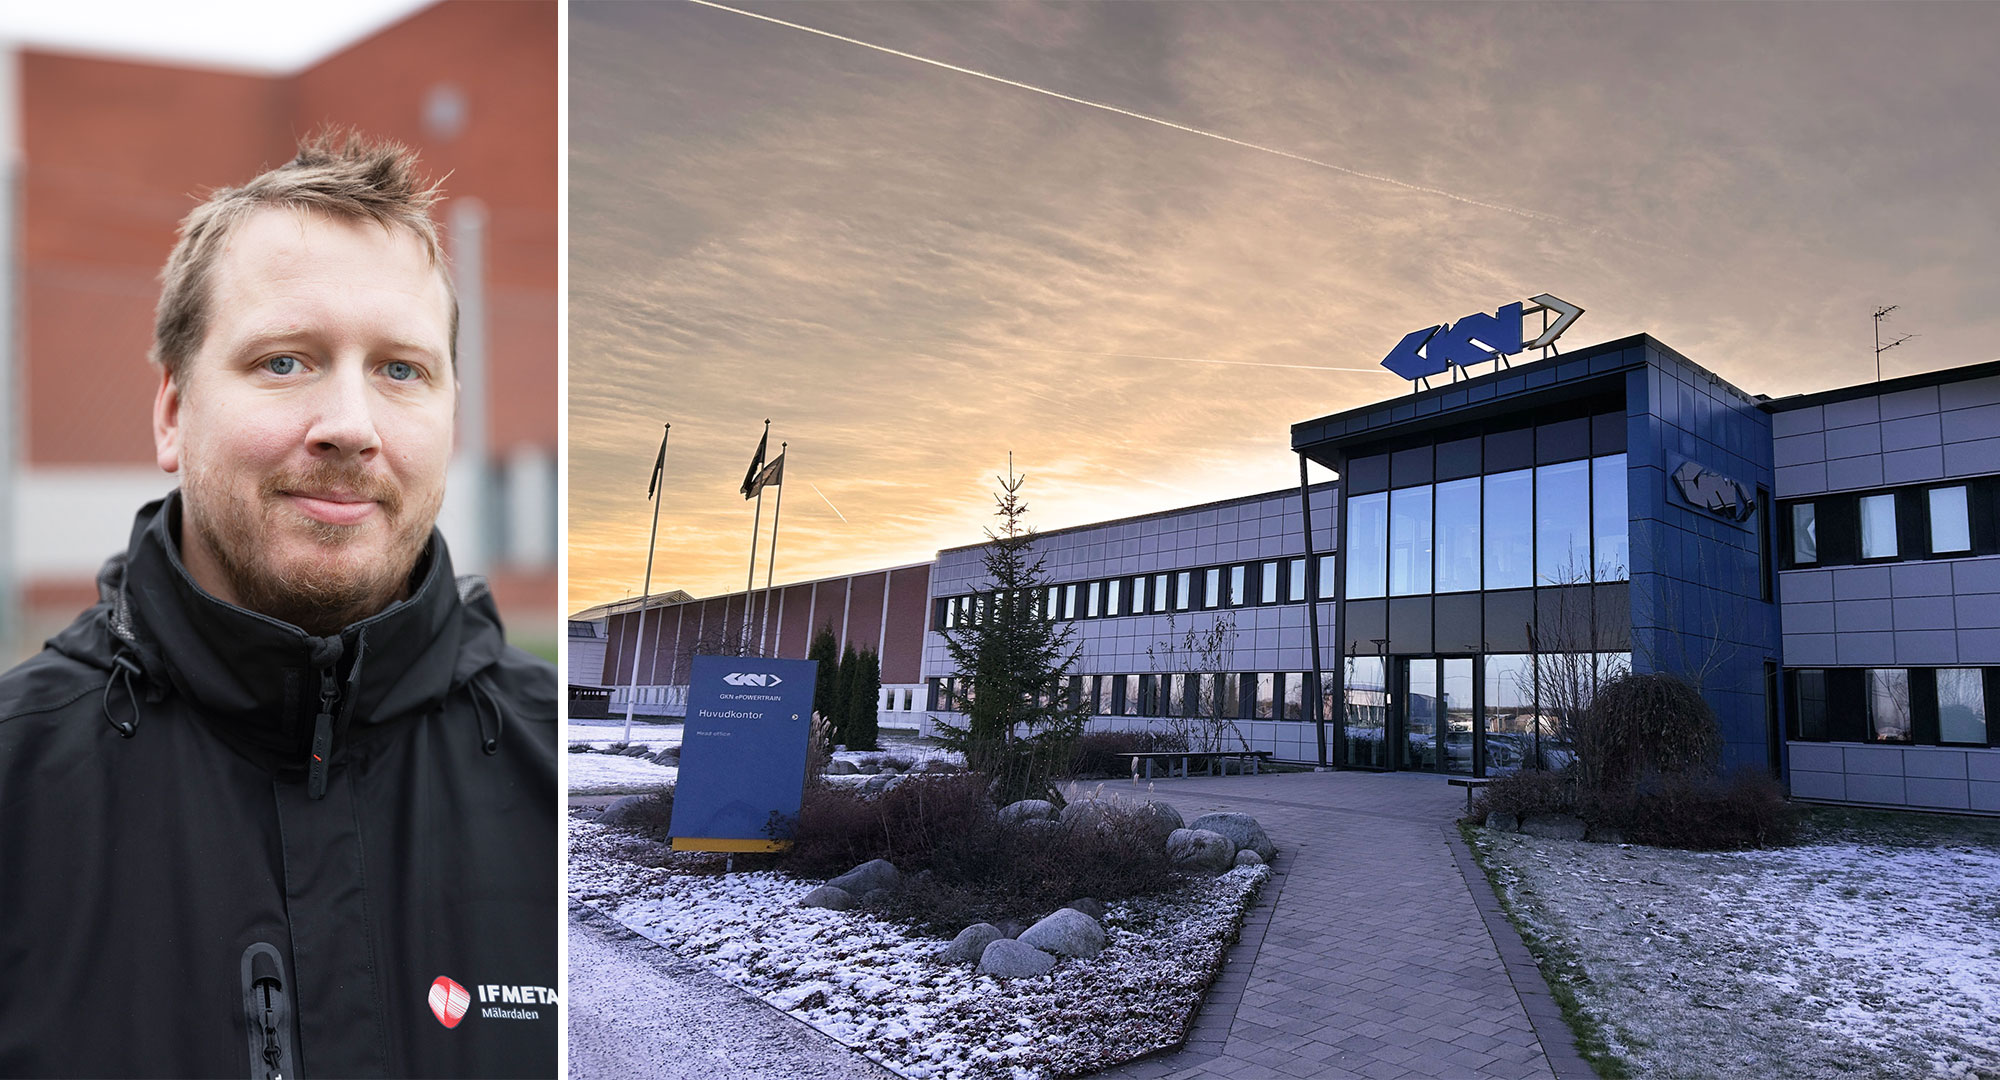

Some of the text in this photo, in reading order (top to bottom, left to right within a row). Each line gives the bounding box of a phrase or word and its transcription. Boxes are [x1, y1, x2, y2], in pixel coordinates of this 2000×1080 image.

[1380, 301, 1523, 381] GKN
[723, 672, 767, 686] GKN
[699, 709, 763, 719] Huvudkontor
[481, 1008, 539, 1019] Mälardalen
